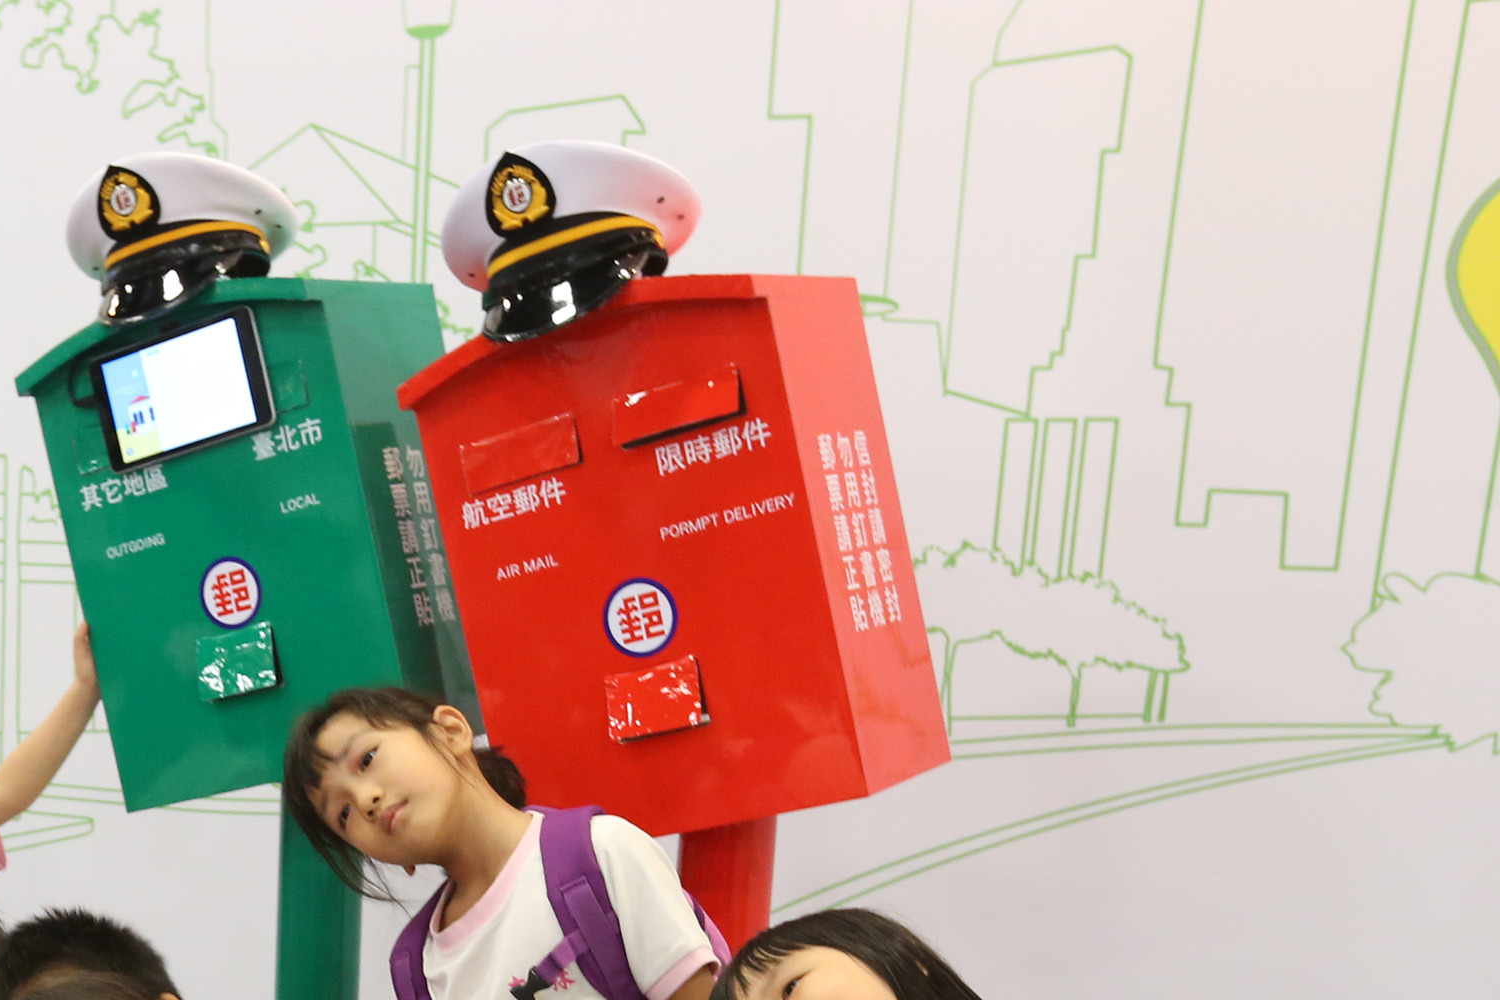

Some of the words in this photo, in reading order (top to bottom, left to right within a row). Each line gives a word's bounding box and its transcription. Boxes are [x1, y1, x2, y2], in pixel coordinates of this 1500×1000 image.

[252, 418, 324, 461] 臺北市
[654, 417, 772, 477] 限時郵件
[79, 464, 168, 511] 其它地區
[280, 493, 321, 514] LOCAL
[461, 477, 567, 530] 航空郵件
[659, 512, 719, 541] PORMPT
[723, 493, 796, 525] DELIVERY
[817, 433, 869, 632] 郵票請正貼
[837, 431, 887, 628] 勿用釘書機
[853, 429, 902, 622] 信封請密封
[106, 533, 166, 559] OUTGOING
[496, 564, 522, 581] AIR
[524, 554, 560, 575] MAIL
[211, 569, 252, 617] 郵
[617, 590, 666, 645] 郵
